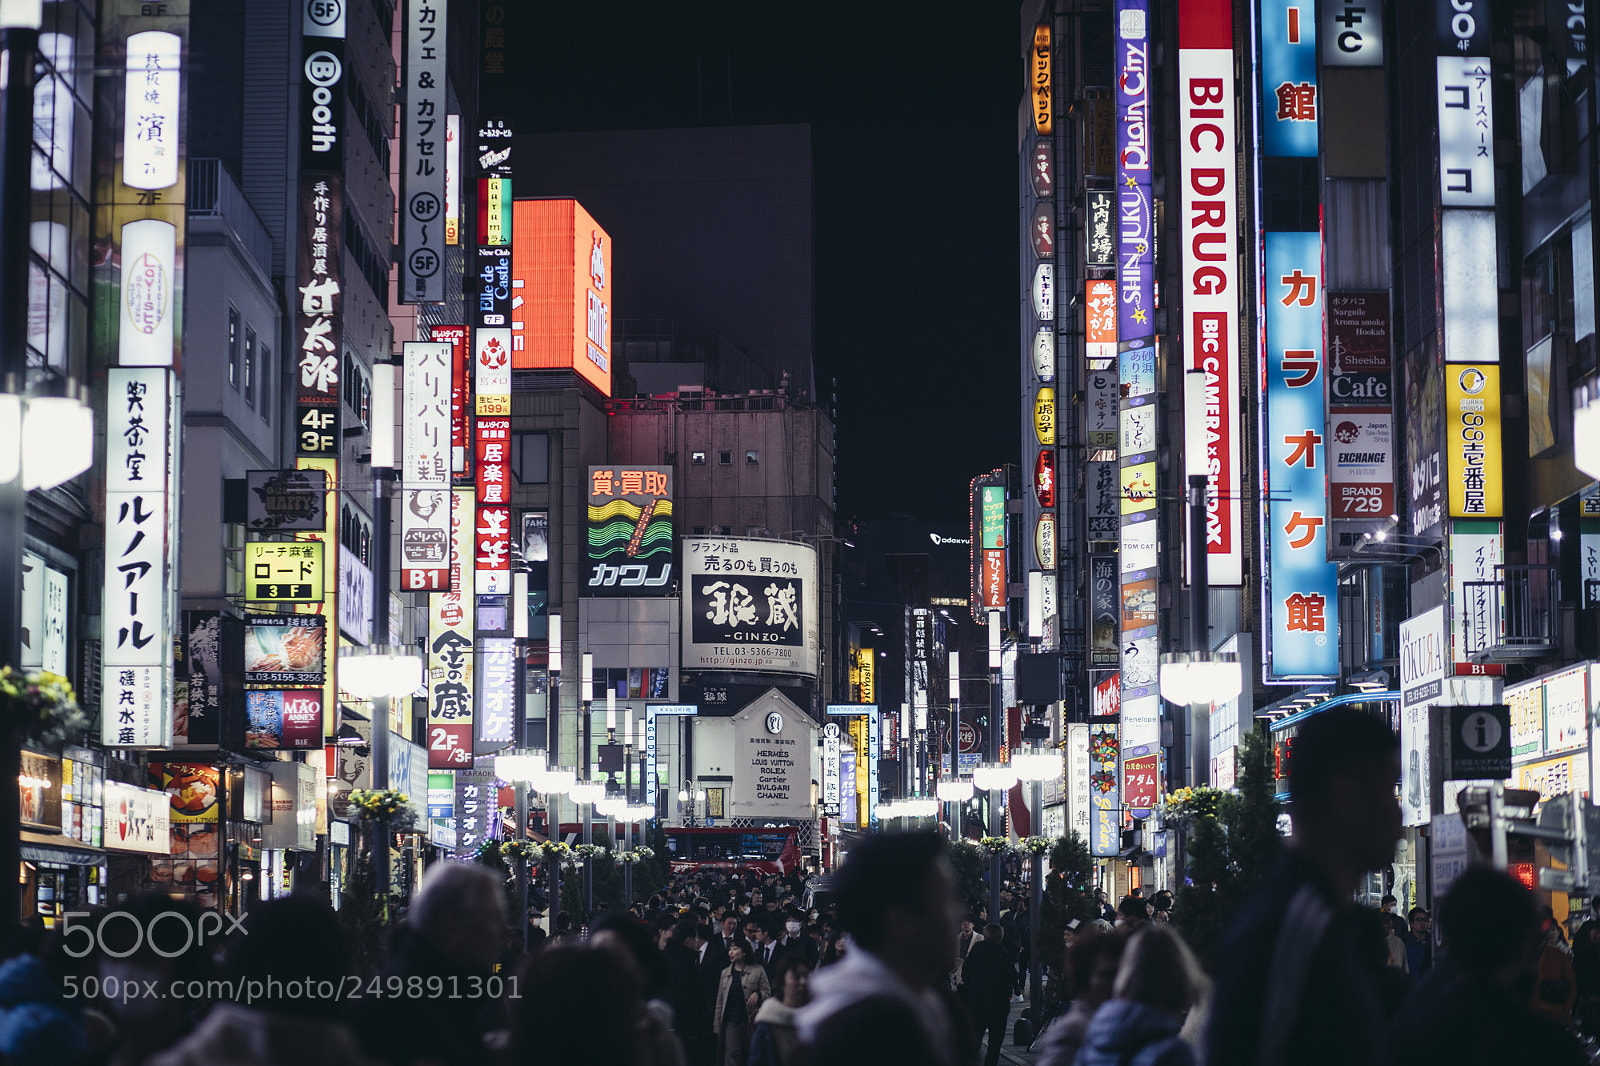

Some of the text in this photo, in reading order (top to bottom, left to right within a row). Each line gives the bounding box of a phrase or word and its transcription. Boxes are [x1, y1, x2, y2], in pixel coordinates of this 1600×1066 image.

[315, 4, 334, 17] 5F
[1457, 40, 1469, 50] 4F
[418, 72, 435, 89] &
[304, 51, 342, 152] Booth
[1474, 65, 1489, 157] ヘアースペース
[416, 98, 436, 177] カプセル
[1189, 78, 1227, 295] BIC DRUG
[312, 181, 330, 275] 手作り居酒屋
[1092, 194, 1110, 254] 山内農場
[415, 200, 434, 270] 8F 5F
[1122, 192, 1149, 304] SHINJUKU
[480, 257, 509, 312] Elle de Castle
[299, 278, 340, 393] 甘太郎
[1202, 319, 1220, 353] BIC
[1356, 328, 1385, 336] Hookah
[1142, 351, 1153, 373] 砂浜
[1345, 355, 1386, 365] Sheesha
[1332, 377, 1387, 398] Cafe
[302, 409, 335, 429] 4F
[1038, 404, 1053, 432] 虎の子
[301, 432, 335, 451] 3F
[1096, 432, 1113, 444] 3F
[1280, 269, 1326, 632] カラオケ館
[1338, 453, 1385, 463] EXCHANGE
[483, 444, 503, 502] 居楽屋
[1342, 487, 1382, 496] BRAND
[1342, 497, 1382, 512] 729
[256, 546, 314, 558] リーチ麻雀
[691, 543, 739, 553] ブランド品
[117, 496, 155, 650] ルノアール
[255, 561, 314, 580] ロード
[588, 563, 672, 586] カワノ
[704, 555, 798, 574] 売るのも買うのも
[410, 570, 438, 589] B1
[700, 657, 763, 665] http://ginzo.jp
[714, 647, 791, 657] TEL.03-5366-7800
[431, 630, 472, 719] 金の蔵
[1472, 665, 1486, 673] B1
[248, 693, 265, 704] 1F
[486, 643, 509, 735] カラオケ
[119, 669, 135, 744] 磯丸水産
[284, 701, 320, 713] MAO
[430, 729, 458, 751] 2F
[1127, 774, 1154, 786] アダム
[1131, 796, 1150, 806] イヴ
[462, 785, 478, 846] カラオケ
